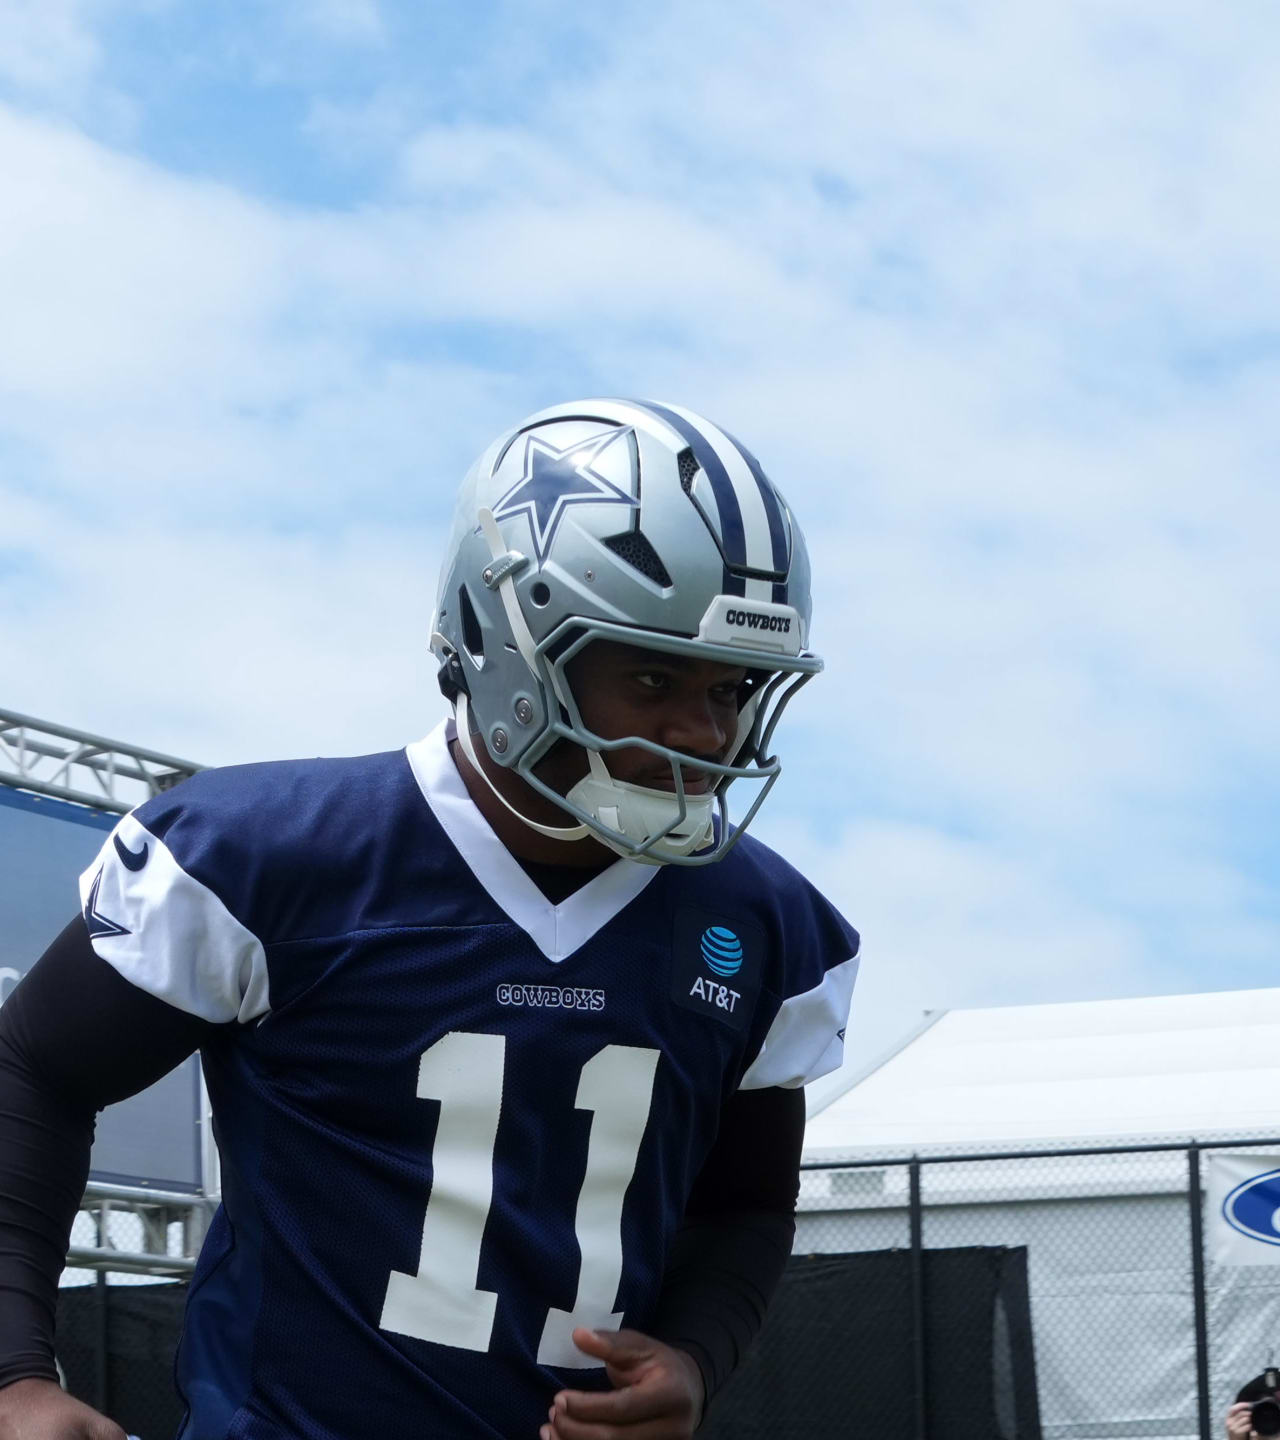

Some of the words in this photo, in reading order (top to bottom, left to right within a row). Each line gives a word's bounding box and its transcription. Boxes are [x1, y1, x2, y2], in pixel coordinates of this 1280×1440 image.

[725, 609, 791, 633] COWBOYS
[496, 983, 605, 1011] COWBOYS
[689, 976, 741, 1013] AT&T
[379, 1030, 661, 1370] 11
